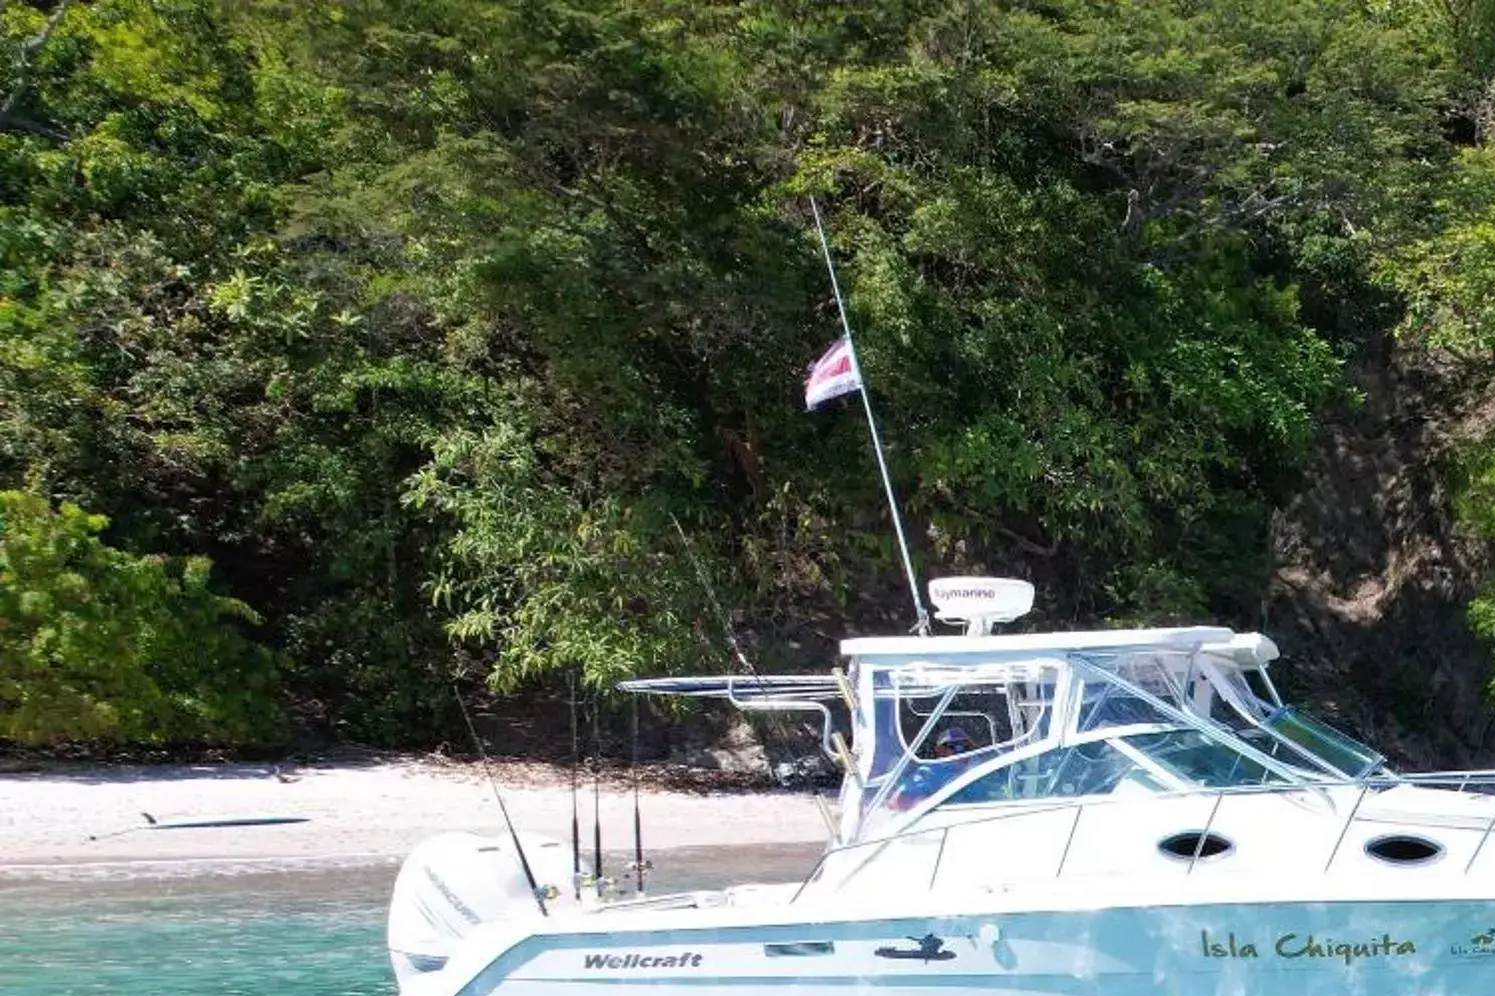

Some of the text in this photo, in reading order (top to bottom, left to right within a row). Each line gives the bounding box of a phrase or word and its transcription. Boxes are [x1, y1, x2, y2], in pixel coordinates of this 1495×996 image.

[1201, 929, 1417, 965] Isla Chiquita
[584, 952, 703, 969] Wellcraft
